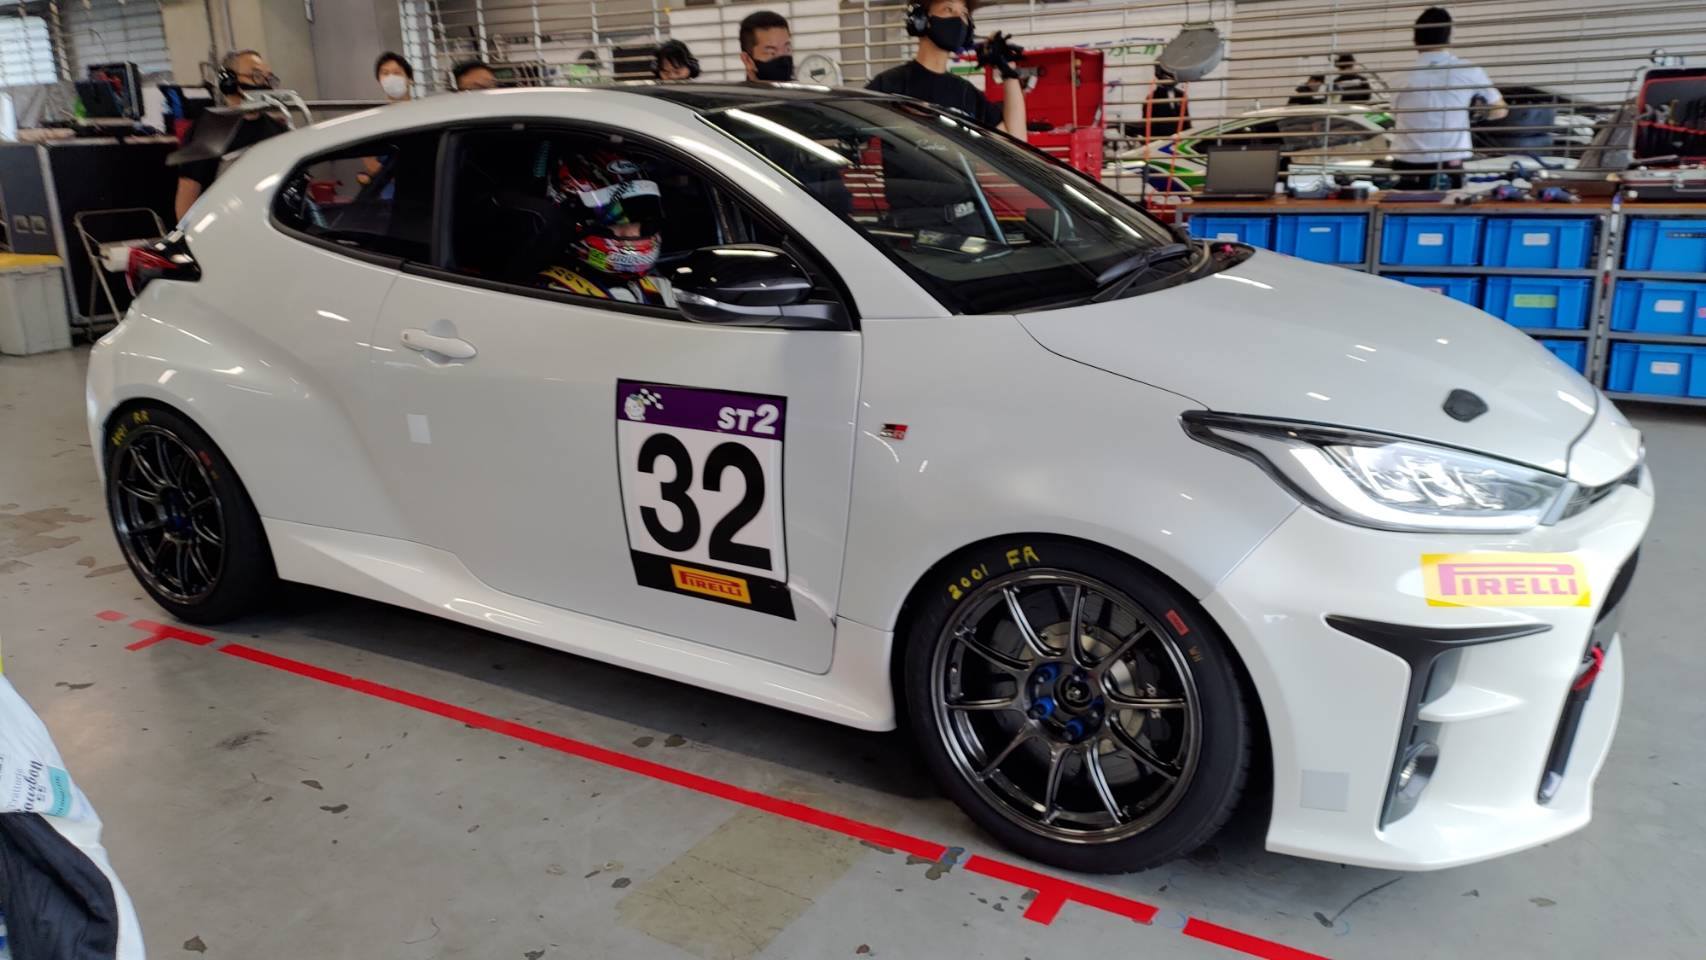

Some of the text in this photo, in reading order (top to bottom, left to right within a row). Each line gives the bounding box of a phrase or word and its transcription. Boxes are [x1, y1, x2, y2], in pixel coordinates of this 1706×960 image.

[717, 404, 779, 434] ST2
[637, 433, 773, 571] 32
[679, 569, 743, 597] PIRELLI
[1438, 563, 1578, 596] PIRELLI
